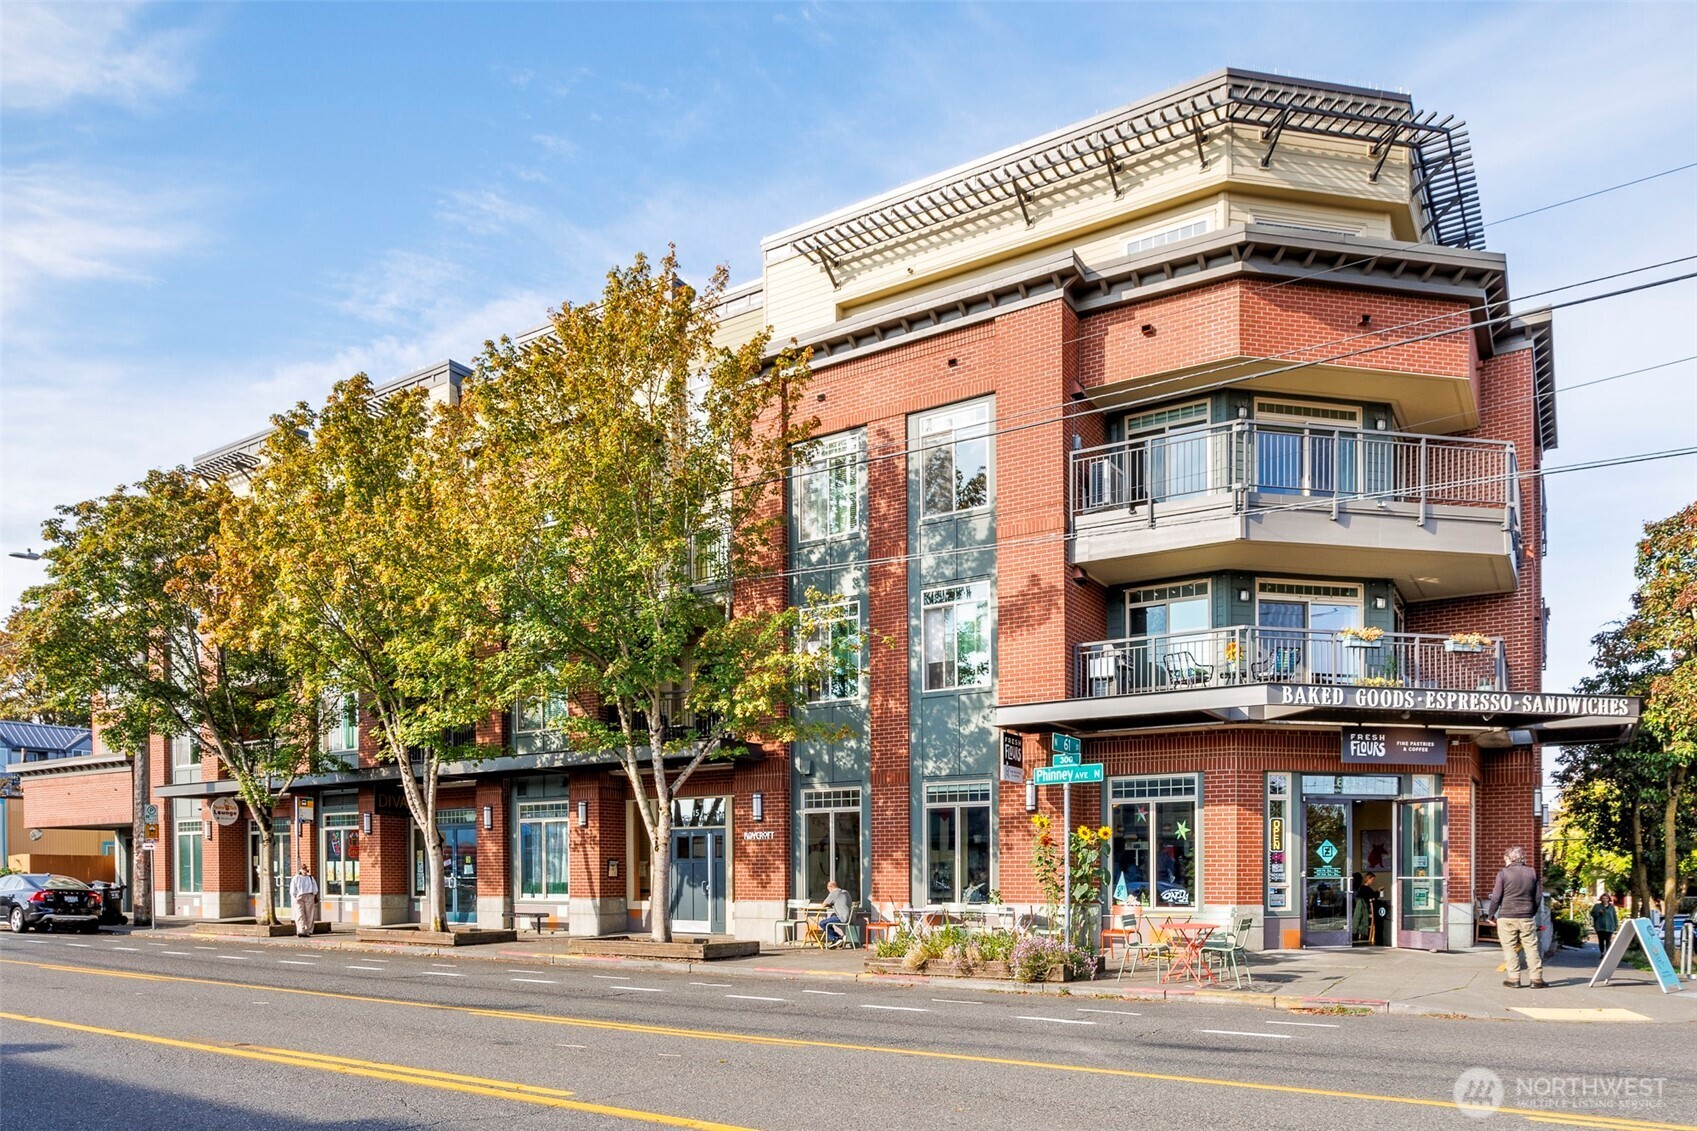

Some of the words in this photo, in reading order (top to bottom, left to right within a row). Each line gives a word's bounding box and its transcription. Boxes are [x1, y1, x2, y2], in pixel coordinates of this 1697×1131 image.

[1282, 685, 1344, 705] BAKED
[1355, 688, 1415, 708] GOODS
[1426, 691, 1512, 711] ESPRESSO
[1522, 695, 1629, 716] SANDWICHES
[1063, 738, 1071, 751] 61
[1350, 733, 1386, 741] FRESH
[1350, 740, 1386, 757] FLOURS
[1036, 768, 1073, 783] Phinney
[1075, 771, 1089, 780] AVE
[1094, 769, 1100, 778] N
[378, 793, 409, 809] DIVA
[213, 809, 237, 817] Lounge
[1273, 820, 1281, 850] OPEN
